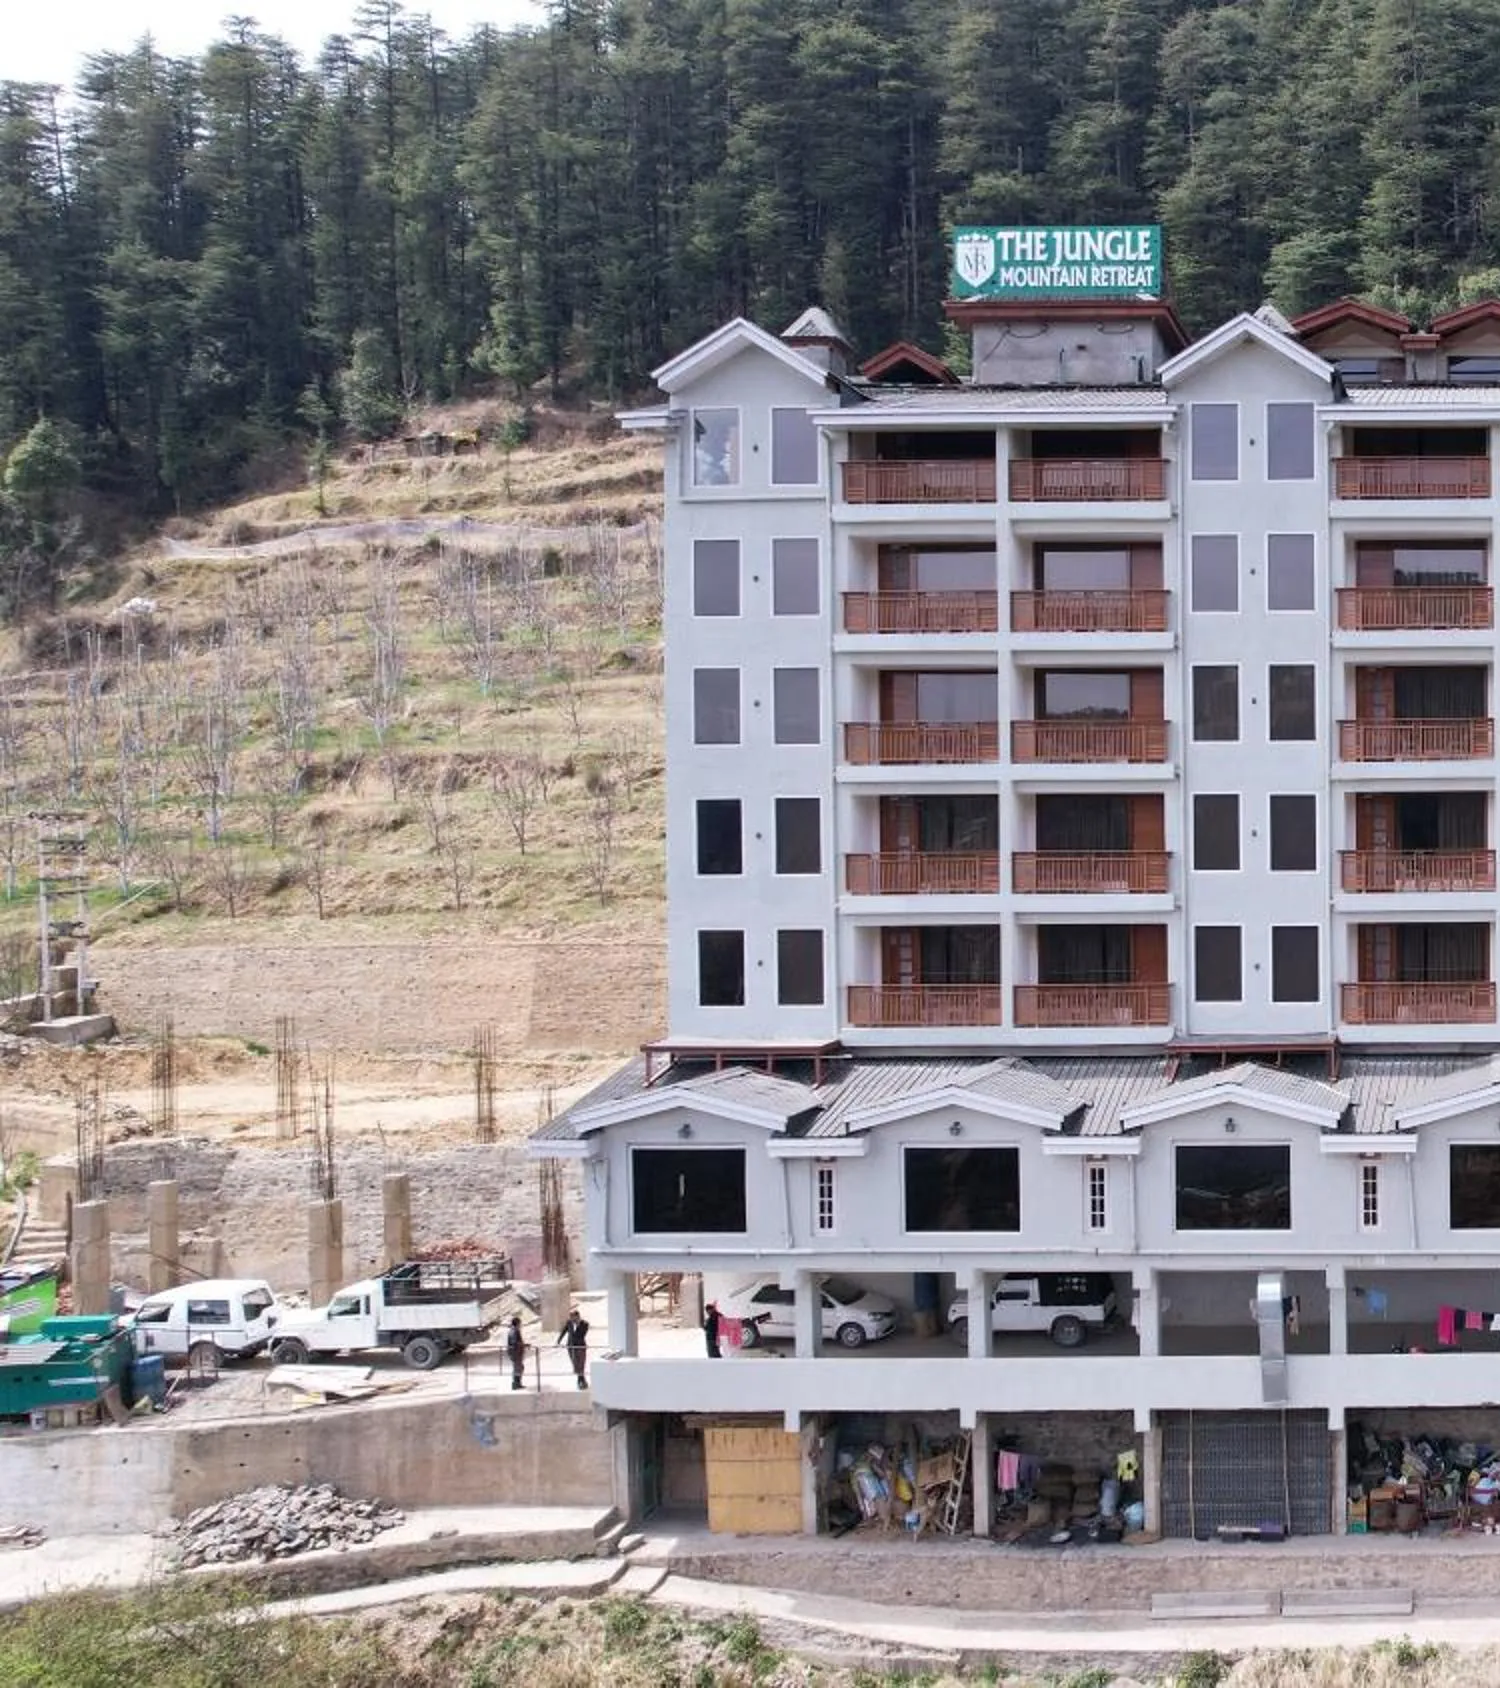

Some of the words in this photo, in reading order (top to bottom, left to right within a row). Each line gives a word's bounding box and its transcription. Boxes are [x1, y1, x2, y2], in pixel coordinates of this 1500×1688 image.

[996, 230, 1048, 261] THE
[1052, 230, 1153, 268] JUNGLE
[1000, 264, 1088, 287] MOUNTAIN
[1091, 264, 1156, 287] RETREAT
